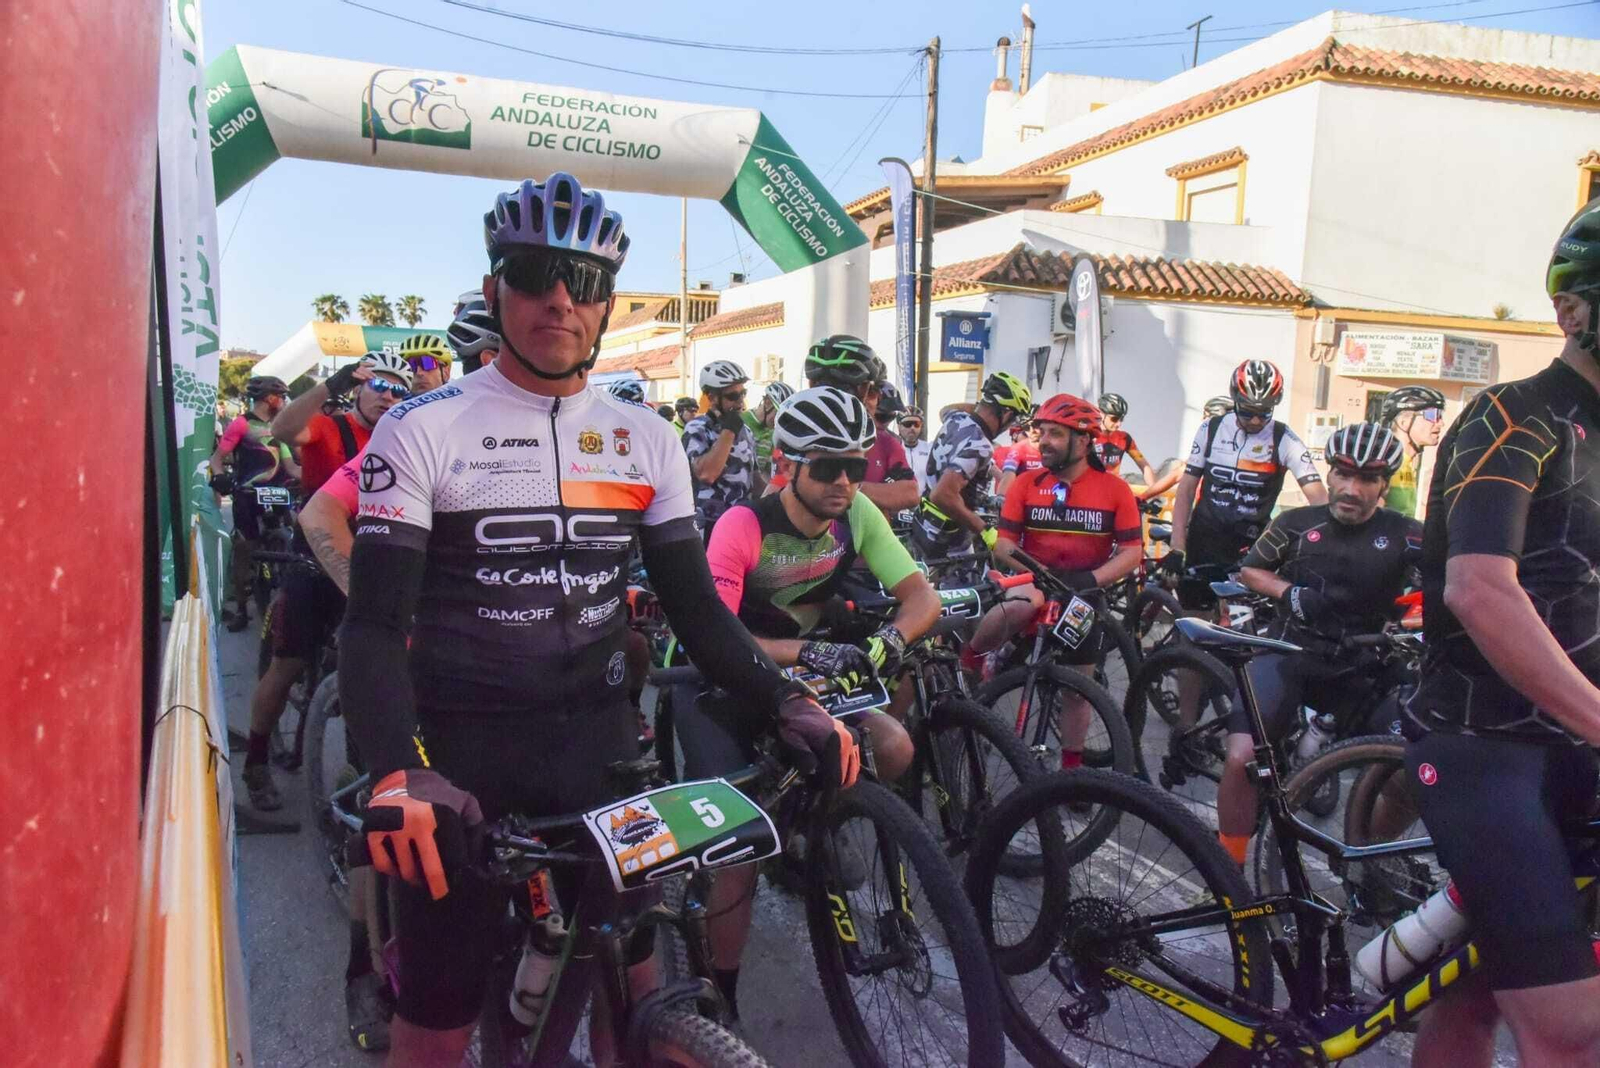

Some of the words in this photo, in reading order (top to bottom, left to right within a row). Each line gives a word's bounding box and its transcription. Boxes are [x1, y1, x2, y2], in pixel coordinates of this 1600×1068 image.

[490, 106, 612, 134] ANDALUZA
[522, 92, 658, 120] FEDERACIÓN
[527, 131, 557, 149] DE
[562, 135, 661, 160] CICLISMO
[754, 157, 813, 223] ANDALUZA
[778, 163, 845, 238] FEDERACIÓN
[760, 184, 782, 204] DE
[777, 202, 828, 257] CICLISMO
[949, 336, 982, 349] Allianz
[500, 438, 540, 448] ATIKA
[689, 797, 726, 829] 5
[1231, 907, 1264, 919] Juanma
[1110, 968, 1190, 1007] SCOTT
